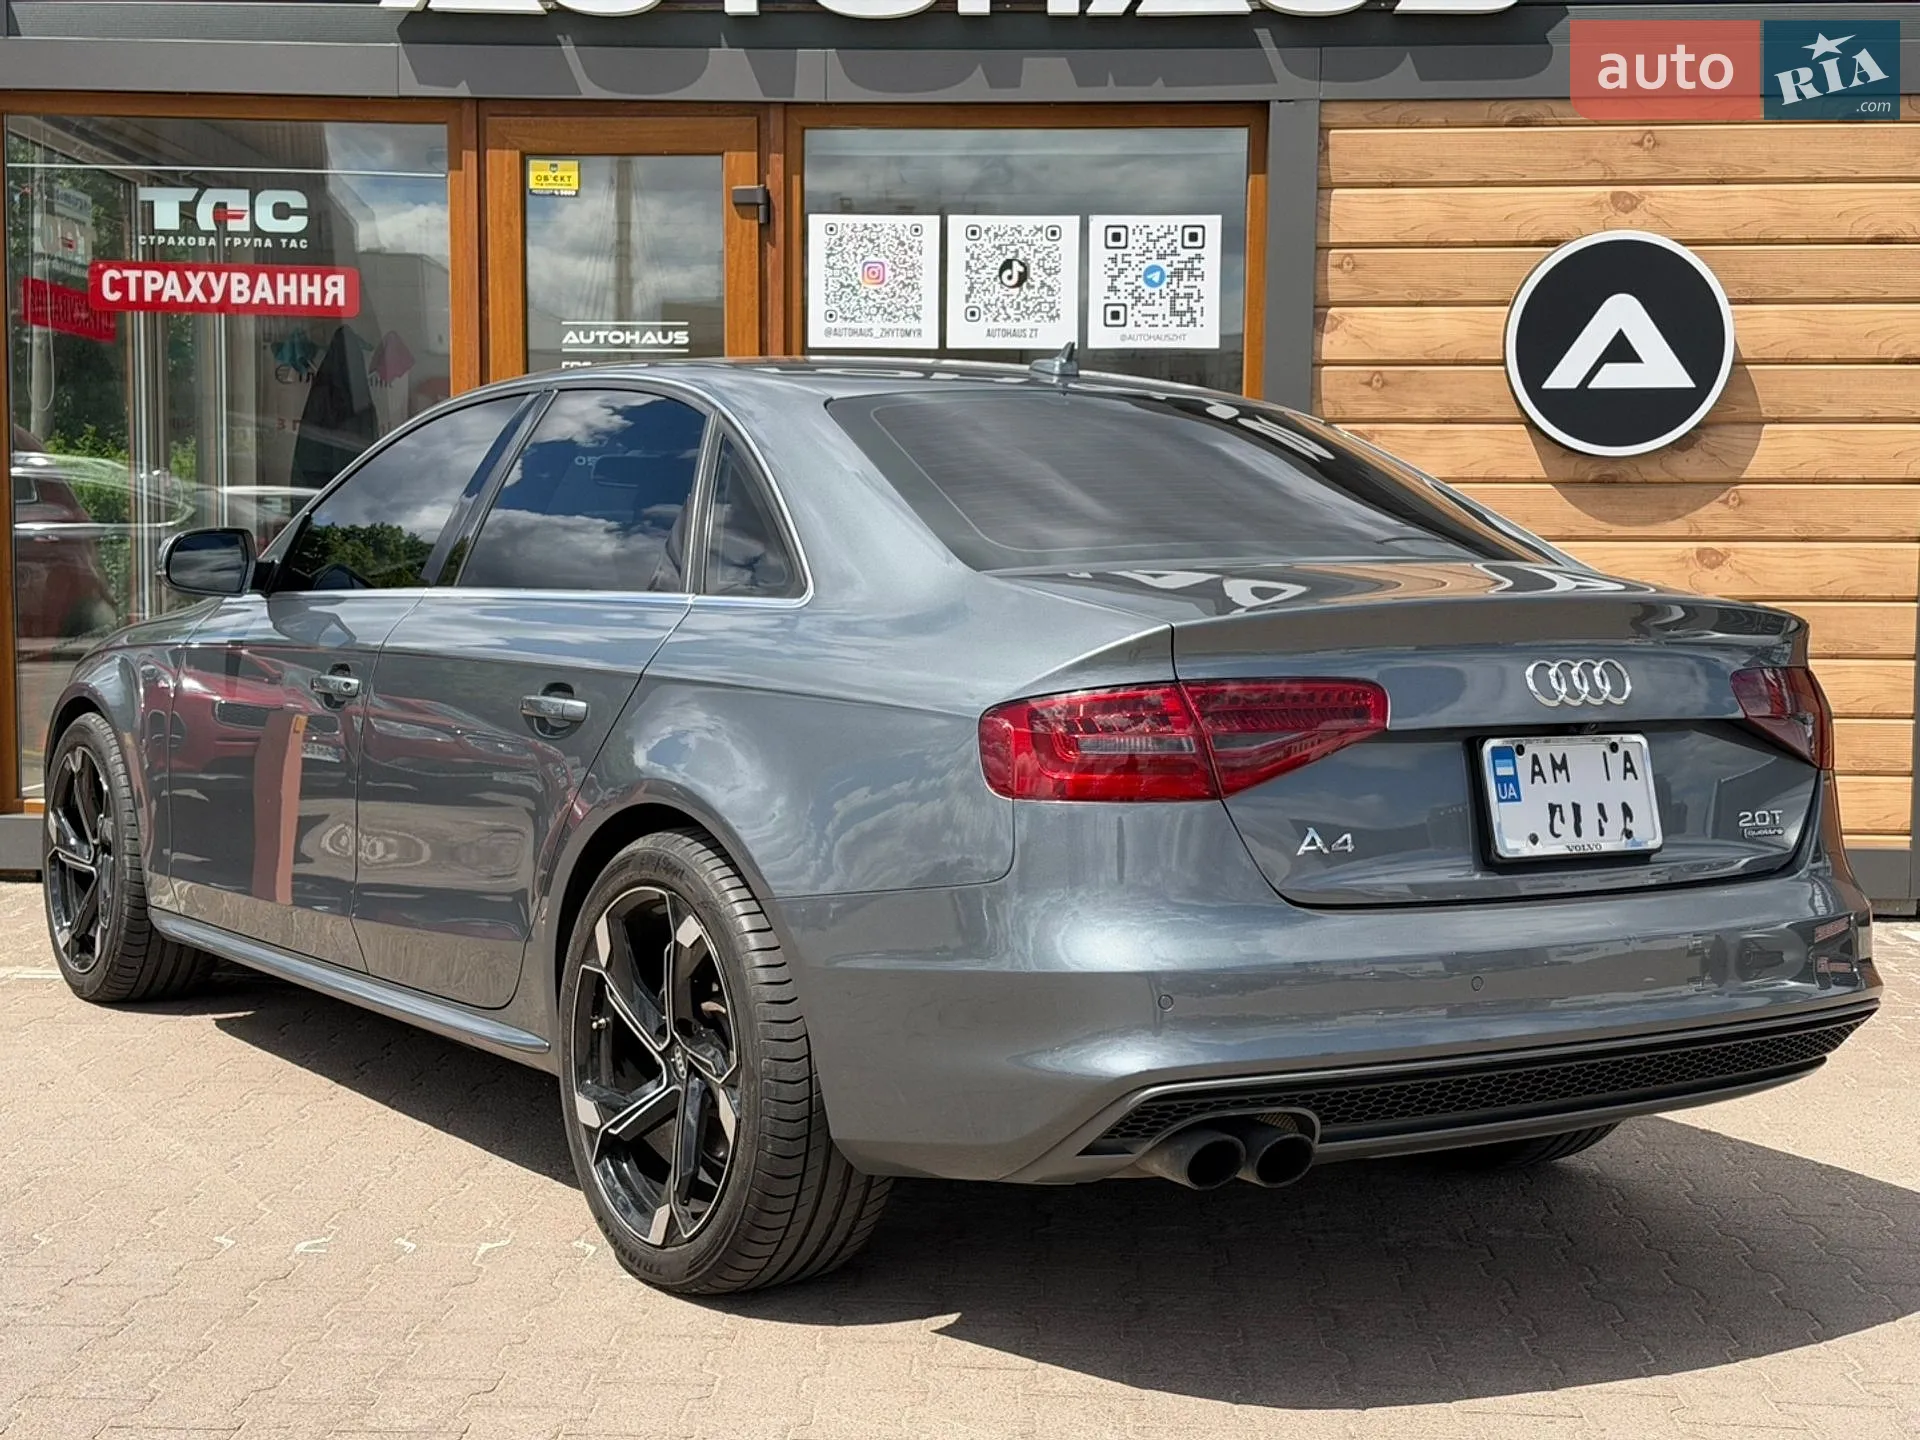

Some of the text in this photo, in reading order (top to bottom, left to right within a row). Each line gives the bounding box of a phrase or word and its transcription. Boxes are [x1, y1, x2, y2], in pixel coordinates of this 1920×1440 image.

[138, 235, 309, 249] СТРАХОВА ГРУПА ТАС
[102, 269, 346, 307] СТРАХУВАННЯ
[561, 330, 690, 345] AUTOHAUS
[824, 328, 922, 339] @AUTOHAUS_ZHYTOMYR
[985, 328, 1039, 339] AUTOHAUS ZT
[1531, 752, 1571, 785] AM
[1498, 782, 1519, 800] UA
[1296, 827, 1355, 856] A4
[1565, 842, 1603, 853] VOLVO
